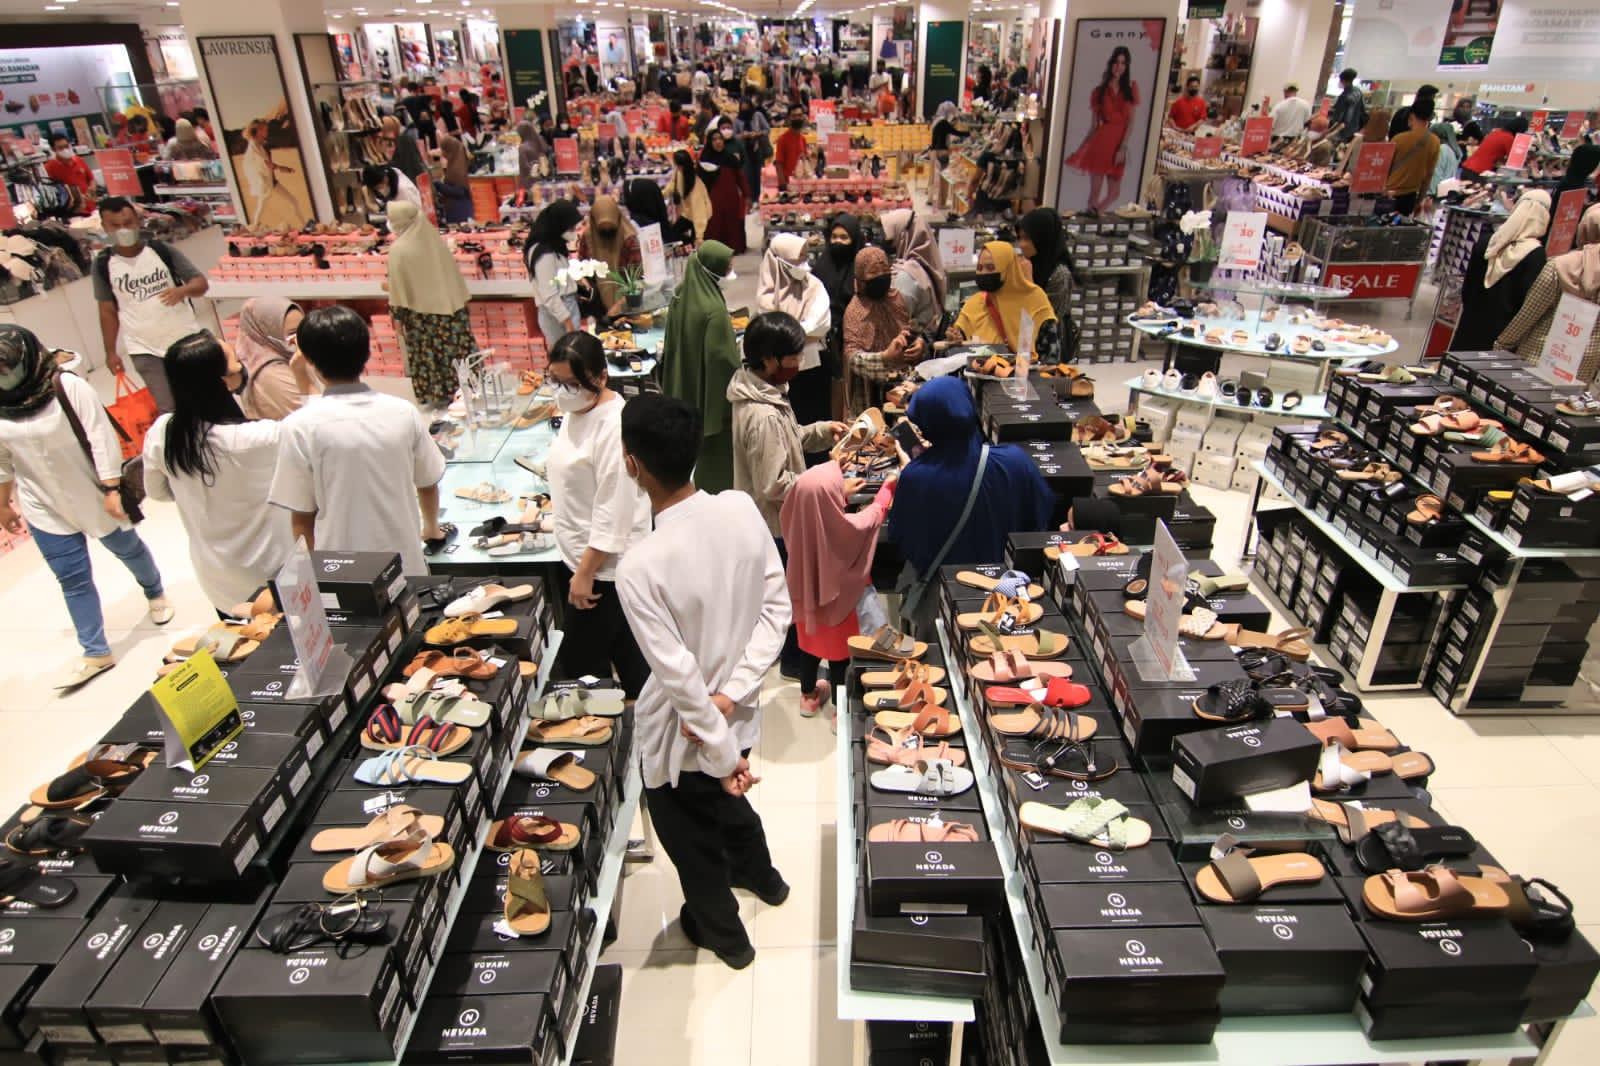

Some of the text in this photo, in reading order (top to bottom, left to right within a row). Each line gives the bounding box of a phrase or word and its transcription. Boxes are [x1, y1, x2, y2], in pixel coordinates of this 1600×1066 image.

[202, 40, 275, 56] LAWRENSIA
[115, 267, 168, 295] Nevada
[1341, 274, 1401, 289] SALE
[135, 280, 169, 300] Denim
[251, 689, 285, 697] NEVADA
[173, 786, 209, 794] NEVADA
[139, 824, 178, 833] NEVADA
[915, 863, 956, 871] NEVADA
[1088, 865, 1128, 873] NEVADA
[1100, 908, 1142, 917] NEVADA
[1256, 915, 1298, 923] NEVADA
[1418, 929, 1463, 938] NEVADA
[286, 957, 328, 967] NEVADA
[474, 961, 510, 969] NEVADA
[1119, 956, 1163, 967] NEVADA
[589, 994, 599, 1024] NEVADA
[441, 1027, 488, 1037] NEVADA
